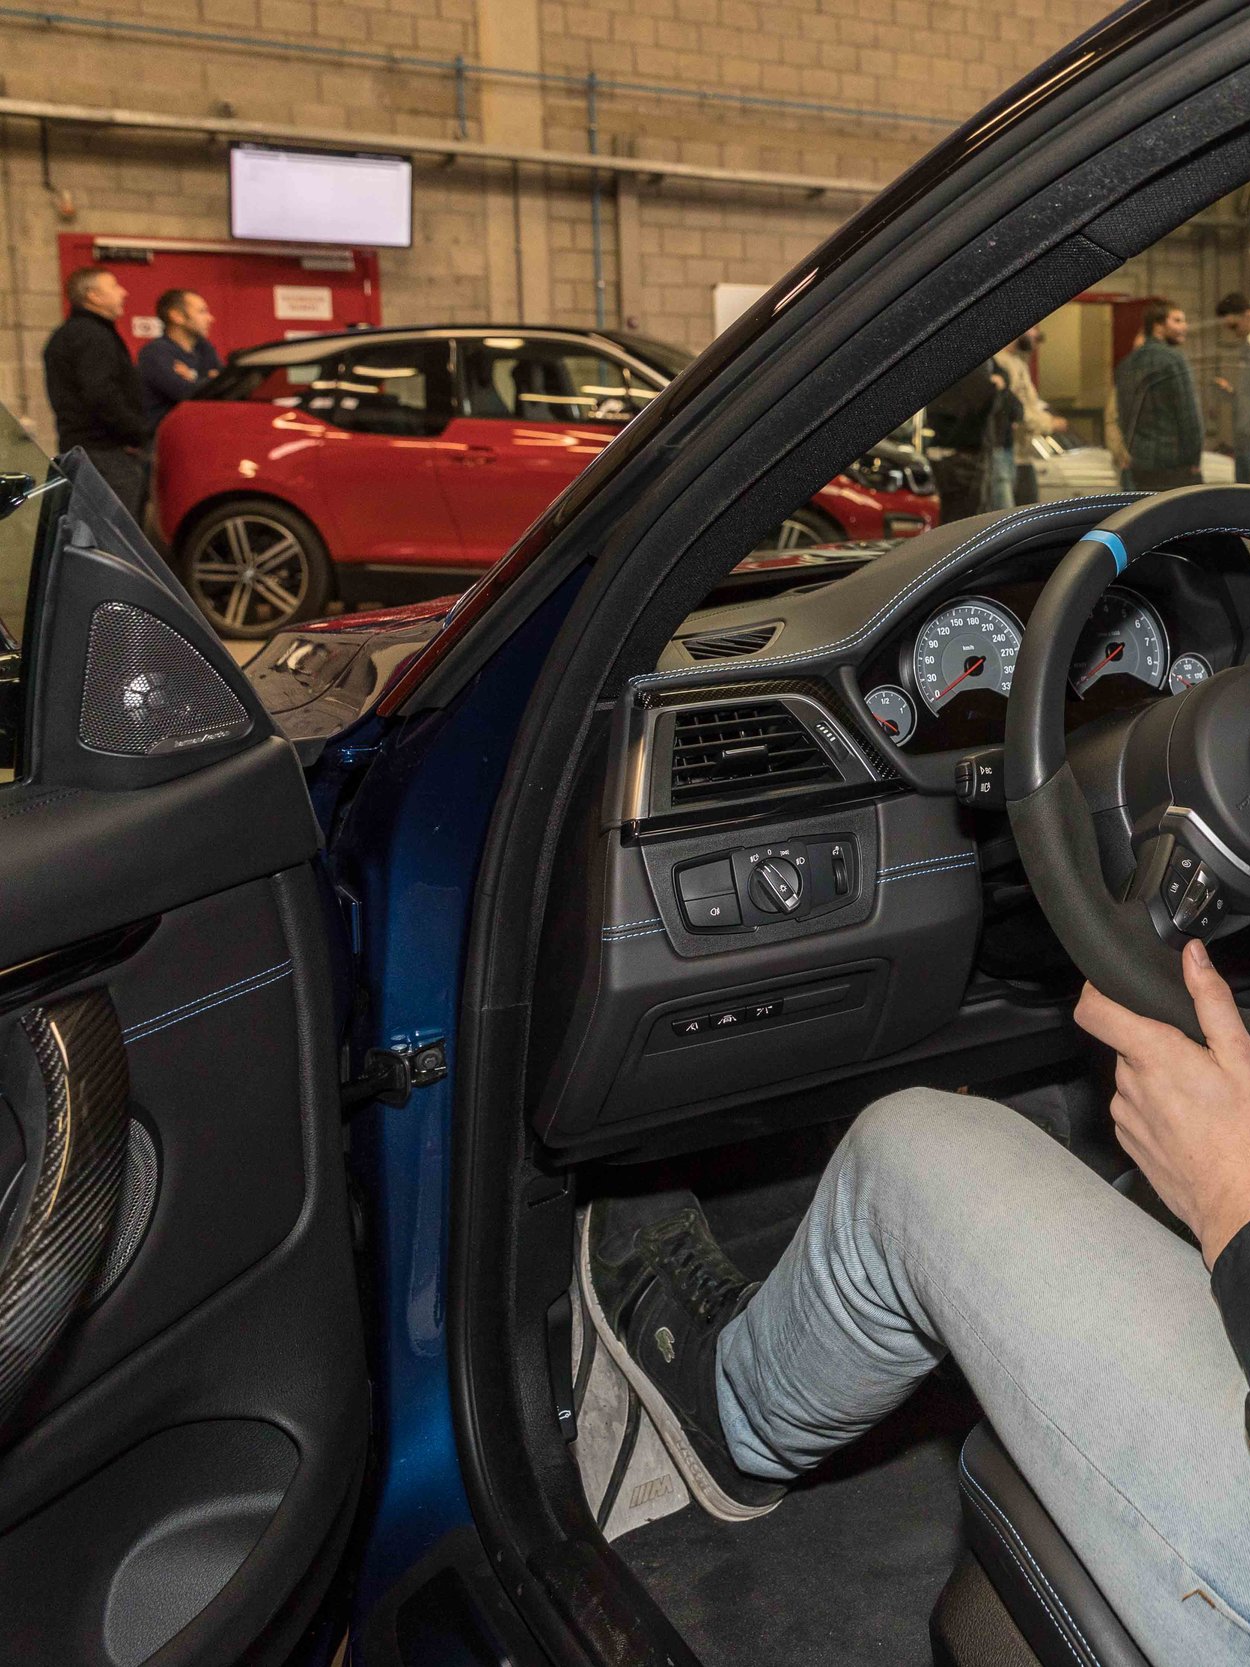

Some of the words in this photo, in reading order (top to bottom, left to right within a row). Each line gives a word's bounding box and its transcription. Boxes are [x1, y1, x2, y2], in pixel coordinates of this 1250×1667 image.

[951, 618, 963, 626] 150
[967, 617, 980, 625] 180
[1135, 620, 1141, 629] 6
[938, 626, 950, 635] 120
[982, 623, 994, 632] 210
[992, 634, 1006, 643] 240
[1144, 637, 1149, 646] 7
[929, 640, 938, 648] 90
[1001, 648, 1014, 657] 270
[925, 656, 935, 664] 60
[1146, 656, 1152, 665] 8
[927, 673, 937, 682] 30
[1001, 681, 1011, 691] 33
[934, 689, 940, 698] 0
[880, 697, 890, 705] 1/2
[1169, 882, 1180, 894] LIM
